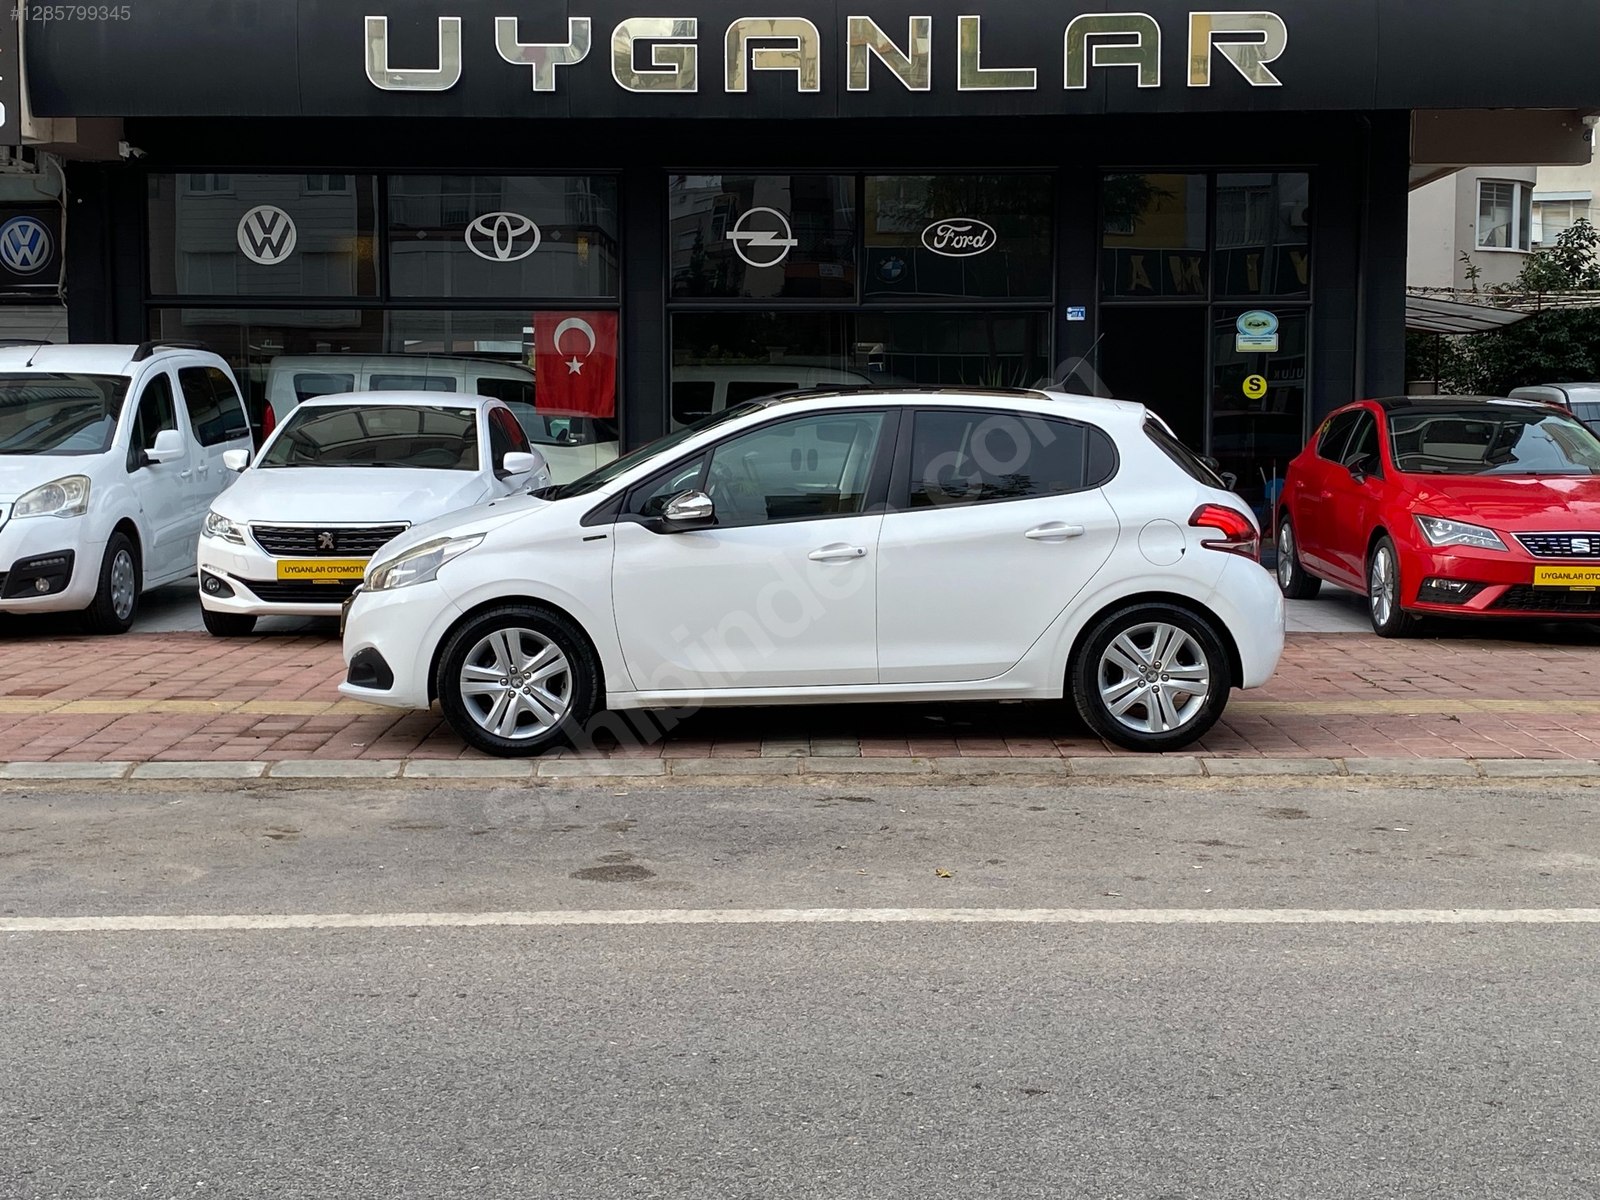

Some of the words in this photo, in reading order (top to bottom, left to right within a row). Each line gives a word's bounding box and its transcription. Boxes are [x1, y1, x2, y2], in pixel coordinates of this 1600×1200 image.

[364, 12, 1288, 93] UYGANLAR
[933, 224, 988, 248] Ford
[1248, 377, 1262, 392] S
[284, 566, 326, 574] UYGANLAR
[1540, 572, 1584, 580] UYGANLAR
